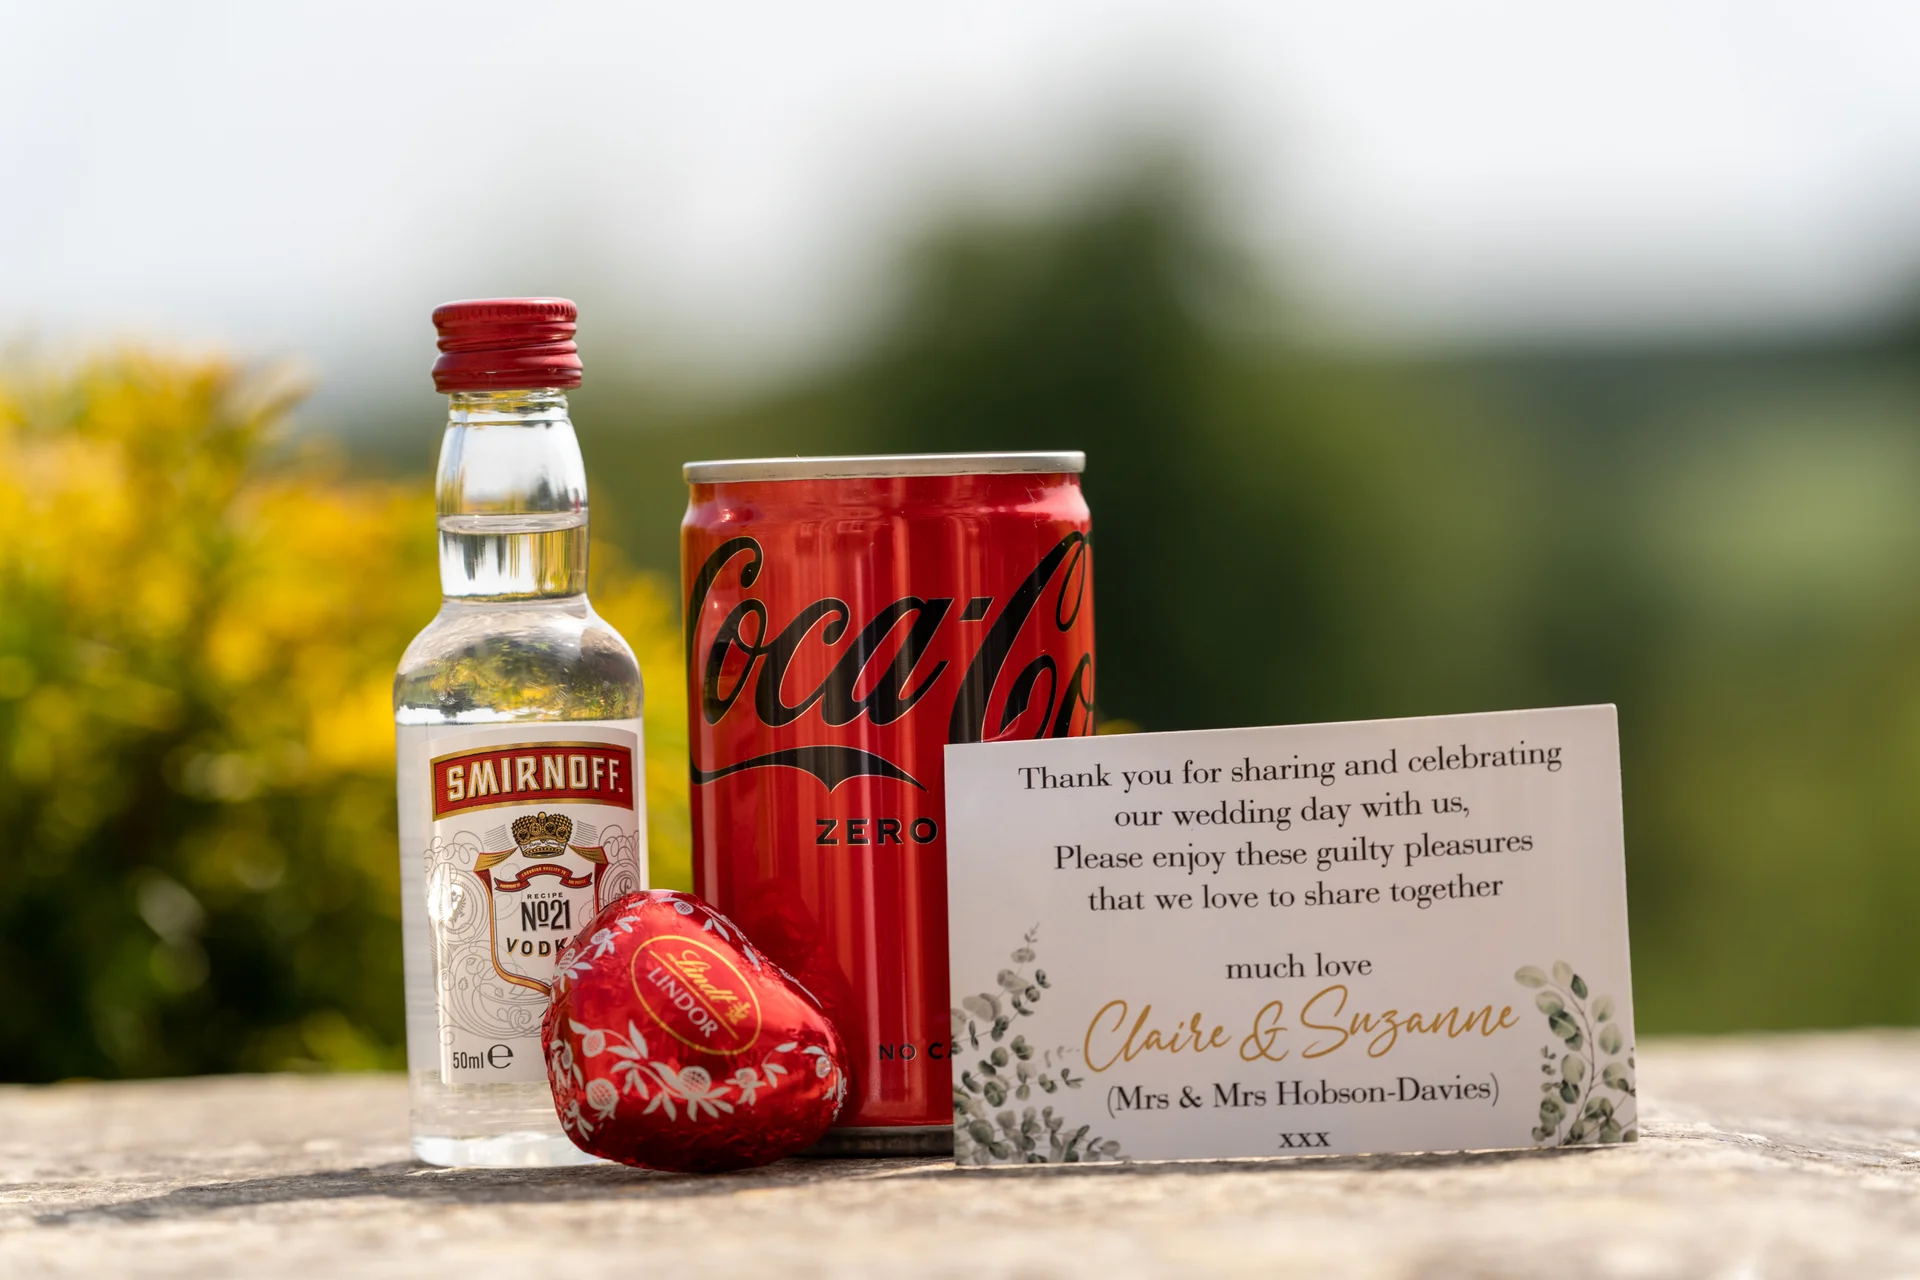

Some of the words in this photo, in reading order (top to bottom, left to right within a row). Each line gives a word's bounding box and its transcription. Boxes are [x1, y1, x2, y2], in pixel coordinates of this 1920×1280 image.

[1019, 764, 1112, 790] Thank
[1121, 770, 1173, 793] you
[1182, 760, 1222, 784] for
[1231, 755, 1335, 786] sharing
[1345, 749, 1398, 776] and
[1408, 740, 1562, 773] celebrating
[1115, 809, 1163, 827] our
[1171, 799, 1292, 831] wedding
[1300, 796, 1351, 827] day
[1360, 790, 1422, 819] with
[1431, 795, 1470, 817] us,
[816, 817, 937, 845] ZERO
[1054, 845, 1143, 869] Please
[1152, 843, 1226, 875] enjoy
[1235, 841, 1307, 866] these
[1316, 836, 1395, 871] guilty
[1404, 832, 1533, 867] pleasures
[1088, 886, 1145, 911] that
[1154, 893, 1193, 909] we
[1202, 884, 1259, 909] love
[1267, 888, 1295, 907] to
[1304, 881, 1380, 906] share
[1390, 873, 1503, 909] together
[506, 937, 577, 957] VODK
[1226, 953, 1305, 979] much
[1315, 952, 1373, 977] love
[666, 949, 738, 1003] Lindt
[647, 966, 719, 1038] LINDOR
[1084, 1000, 1232, 1072] Claire
[1239, 1000, 1289, 1062] &
[1300, 985, 1520, 1059] Suzanne
[453, 1052, 484, 1069] 50ml
[879, 1043, 917, 1061] NO
[1107, 1084, 1169, 1119] (Mrs
[1178, 1086, 1203, 1109] &
[1212, 1082, 1267, 1108] Mrs
[1276, 1073, 1500, 1108] Hobson-Davies)
[1278, 1131, 1332, 1149] xxx
